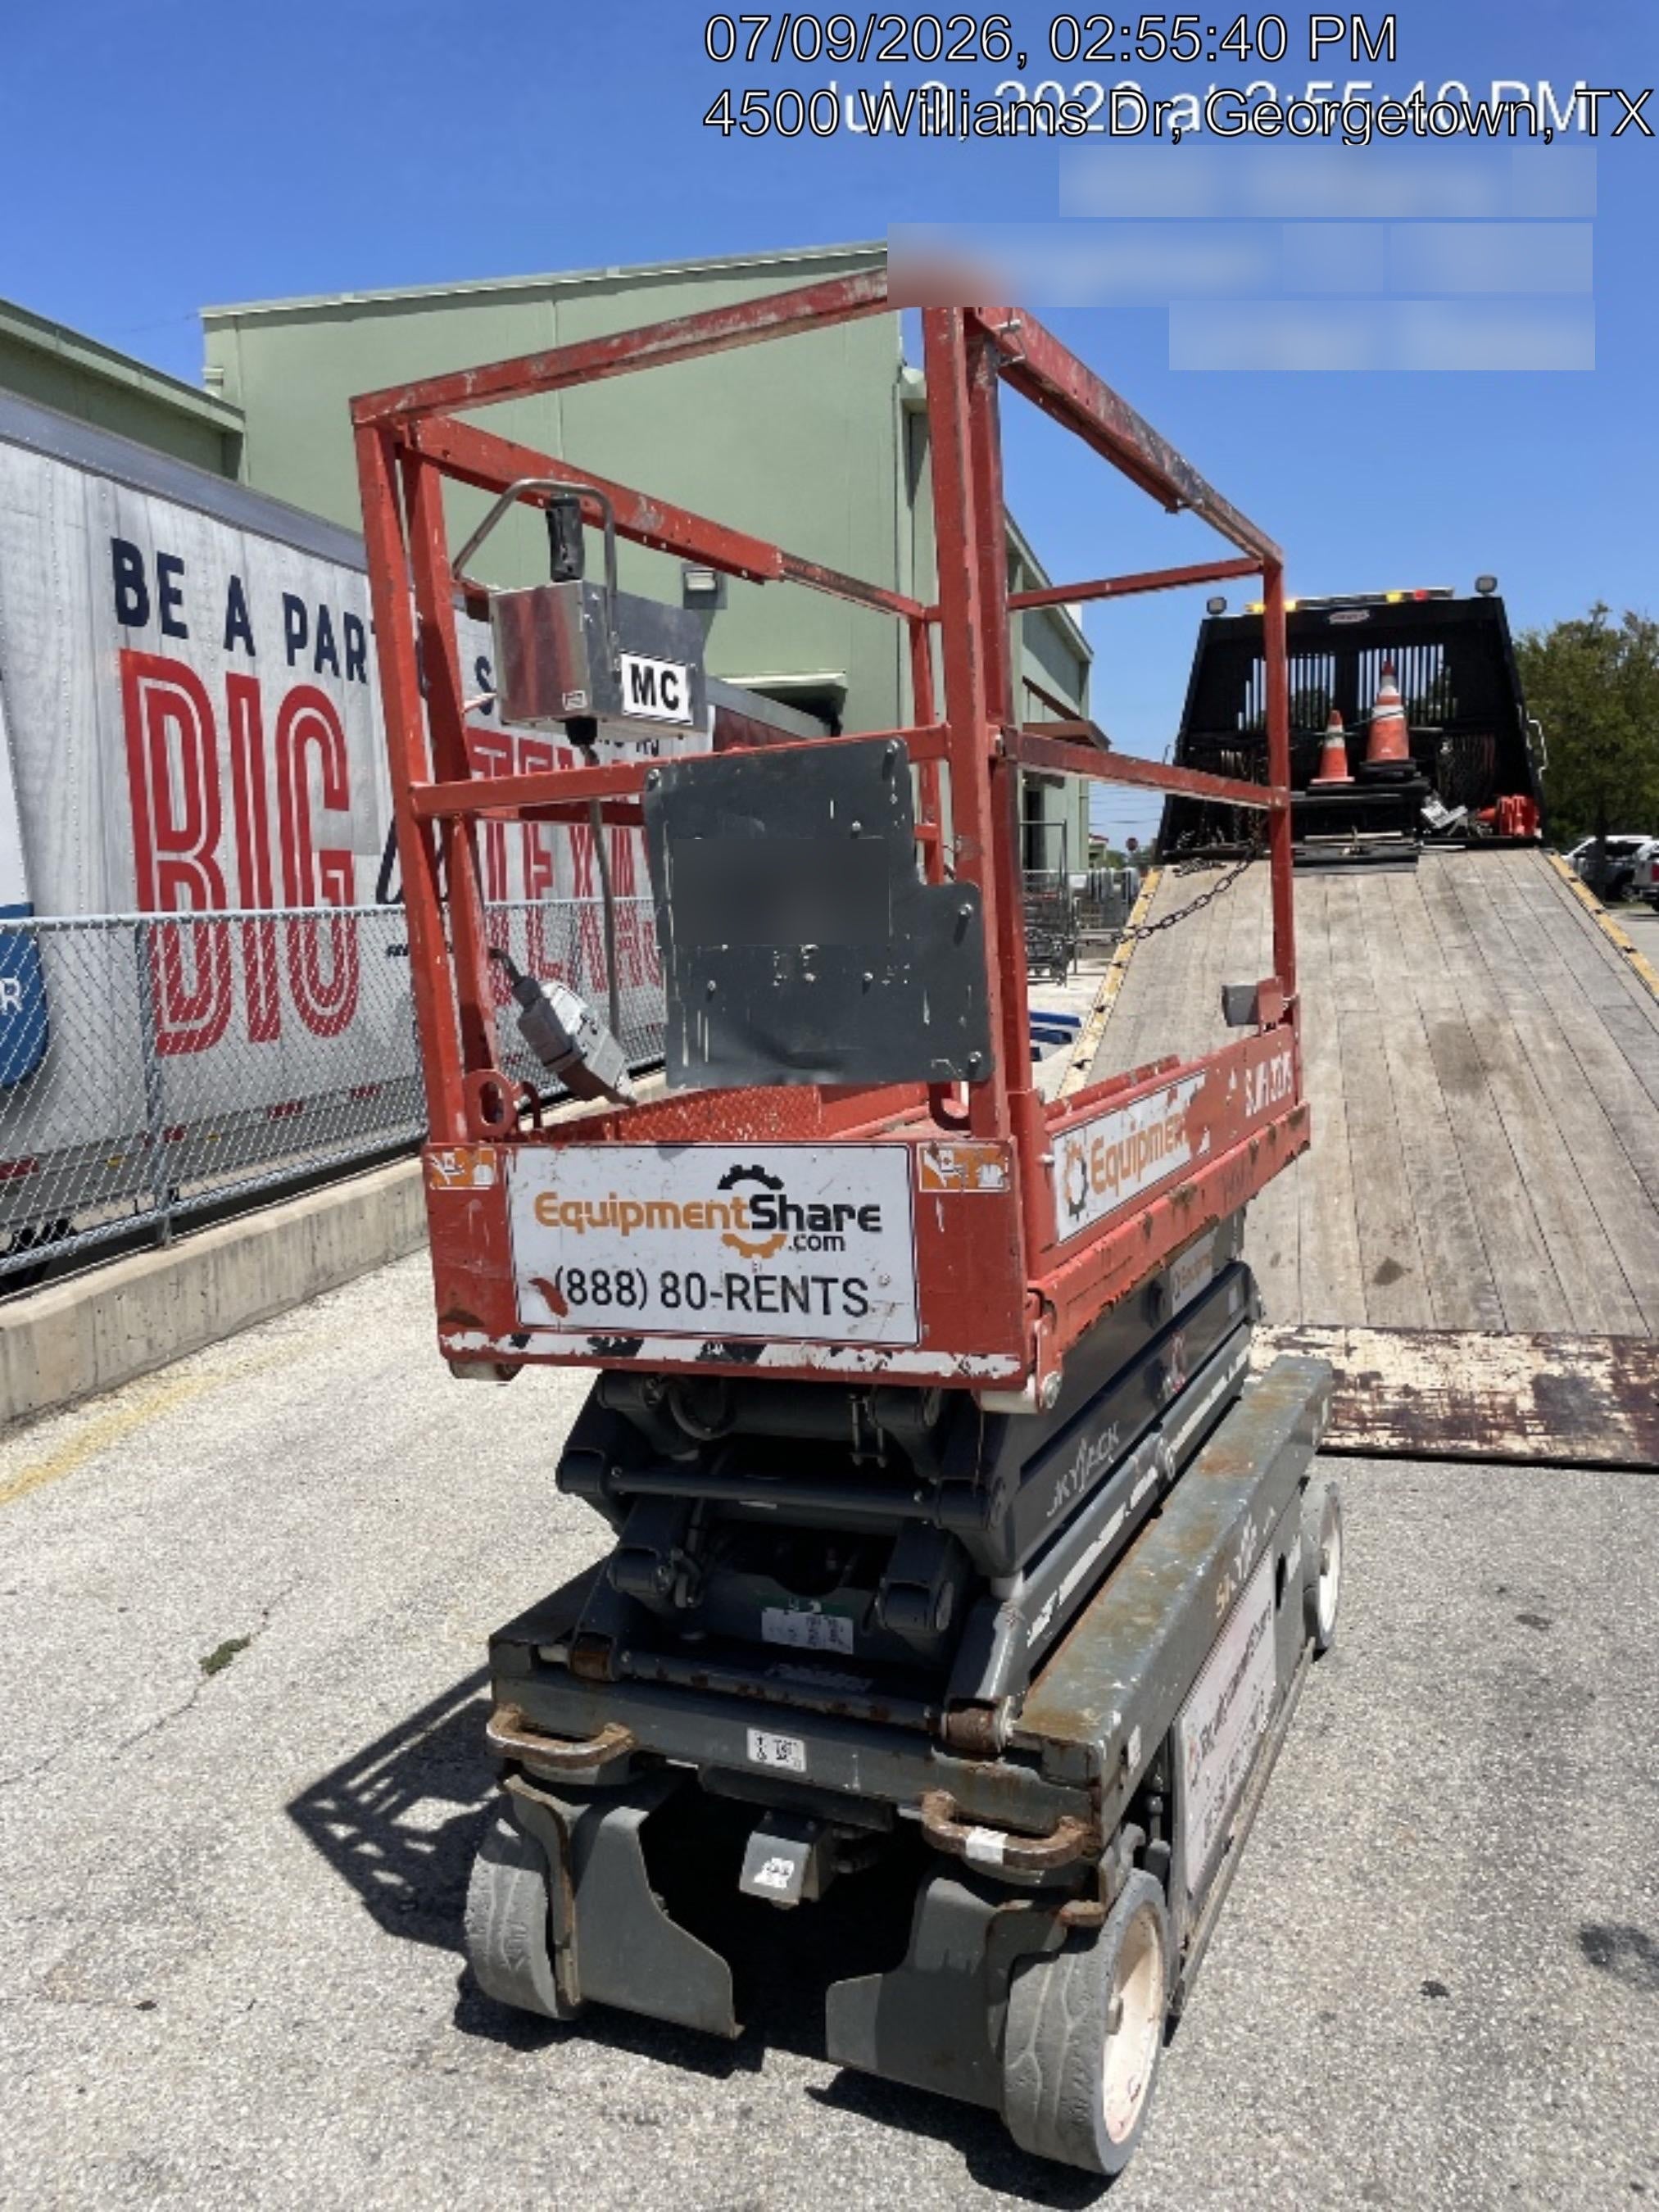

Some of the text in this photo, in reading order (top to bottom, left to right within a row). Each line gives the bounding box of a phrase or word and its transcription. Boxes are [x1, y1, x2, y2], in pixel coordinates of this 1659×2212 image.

[110, 537, 189, 641] BE
[223, 574, 256, 657] A
[282, 591, 379, 685] PAR
[630, 664, 680, 711] MC
[119, 648, 663, 1057] BIG TEXA
[533, 1191, 882, 1238] EquipmentShare
[787, 1233, 846, 1253] .com
[555, 1266, 870, 1318] (888) 80-RENTS
